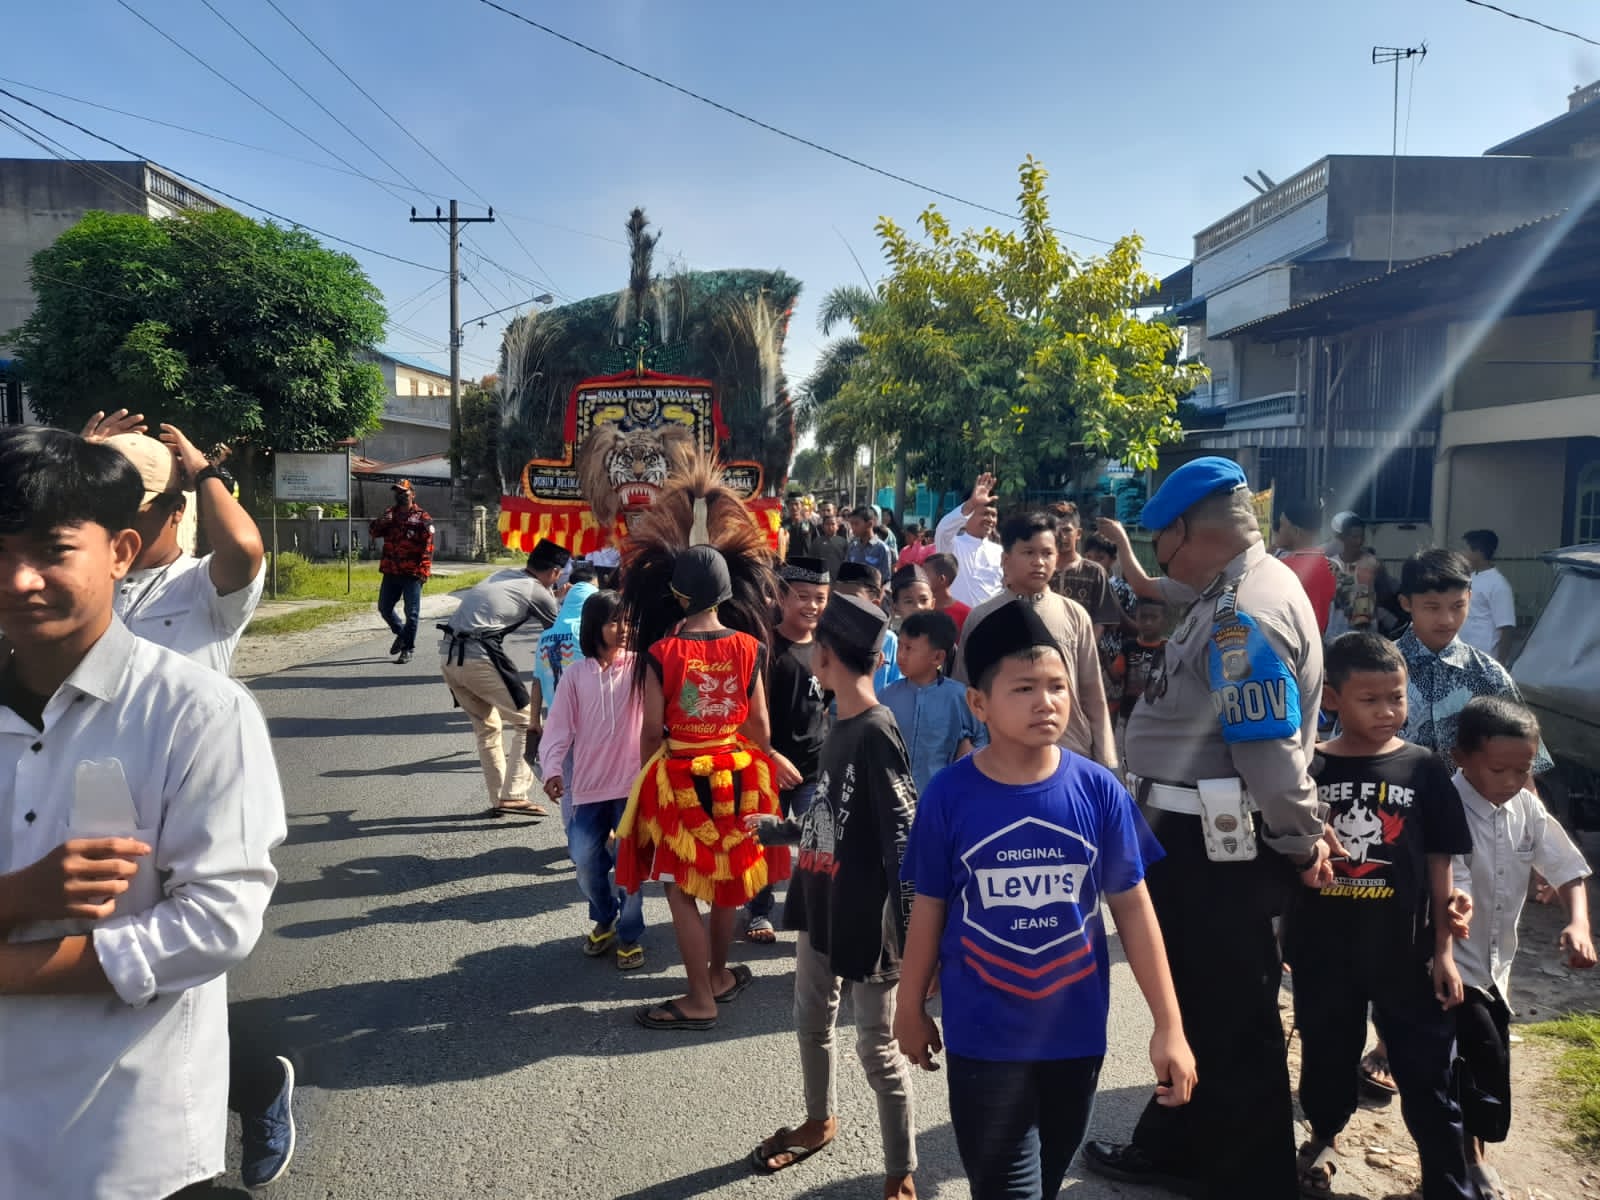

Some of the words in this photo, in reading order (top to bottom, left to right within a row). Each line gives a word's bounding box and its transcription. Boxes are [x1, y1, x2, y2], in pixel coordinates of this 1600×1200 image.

[598, 390, 625, 399] SINAR
[626, 390, 653, 399] MUDA
[655, 389, 690, 399] BUDAYA
[687, 659, 734, 672] Patih
[1210, 679, 1288, 725] PROV
[1317, 782, 1354, 802] REE
[1360, 781, 1415, 807] FIRE
[996, 847, 1065, 861] ORIGINAL
[1010, 917, 1058, 930] JEANS
